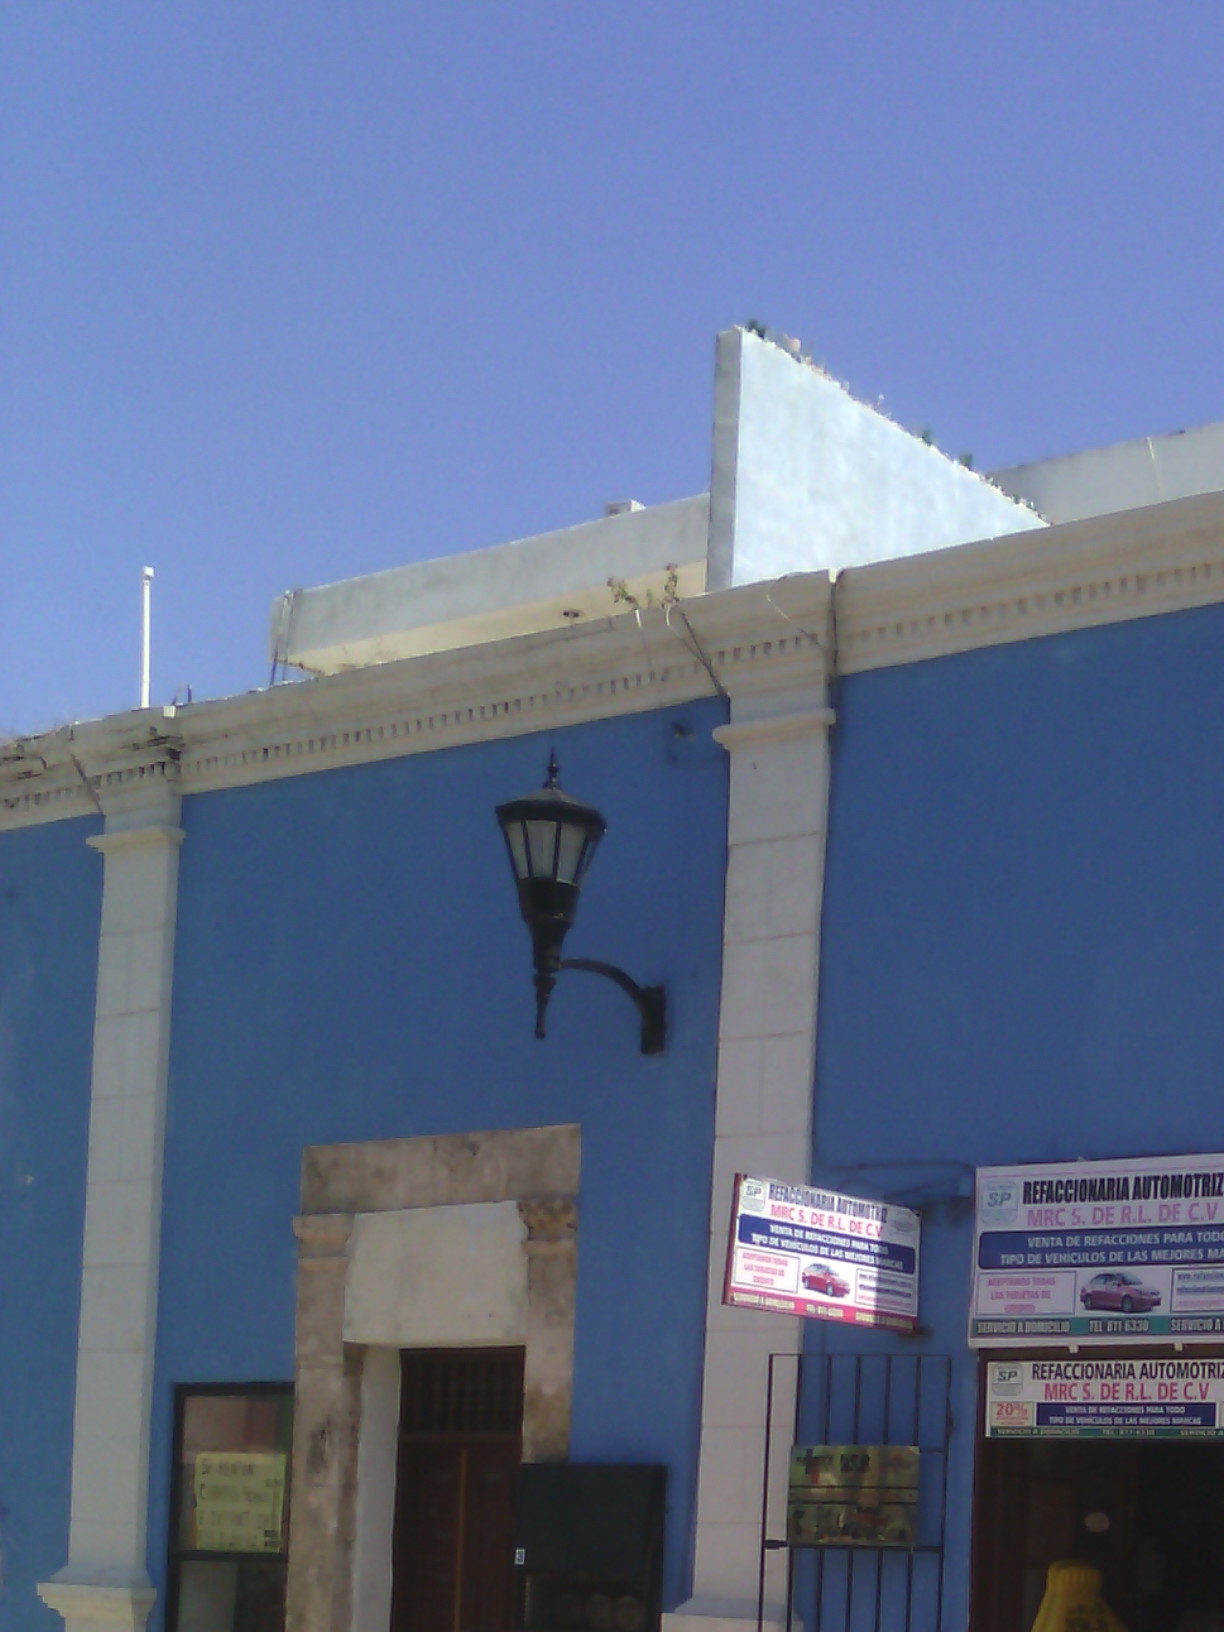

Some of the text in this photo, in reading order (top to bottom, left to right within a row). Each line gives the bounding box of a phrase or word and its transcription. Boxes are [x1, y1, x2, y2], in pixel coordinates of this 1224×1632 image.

[1022, 1172, 1224, 1205] REFACCIONARIA AUTOMOTRIZ
[1026, 1201, 1219, 1227] MRC S. DE R.L. DE C.V
[1027, 1236, 1063, 1249] VENTA
[1065, 1235, 1081, 1248] DE
[1083, 1233, 1160, 1247] REFACCIONES
[1163, 1231, 1194, 1245] PARA
[1000, 1253, 1024, 1265] TIPO
[1027, 1252, 1042, 1265] DE
[1108, 1251, 1125, 1263] DE
[1127, 1249, 1148, 1262] LAS
[1151, 1248, 1204, 1261] MEJORES
[1032, 1362, 1136, 1380] REFACCIONARIA
[1044, 1381, 1210, 1401] MRC S. DE R.L. DE C.V
